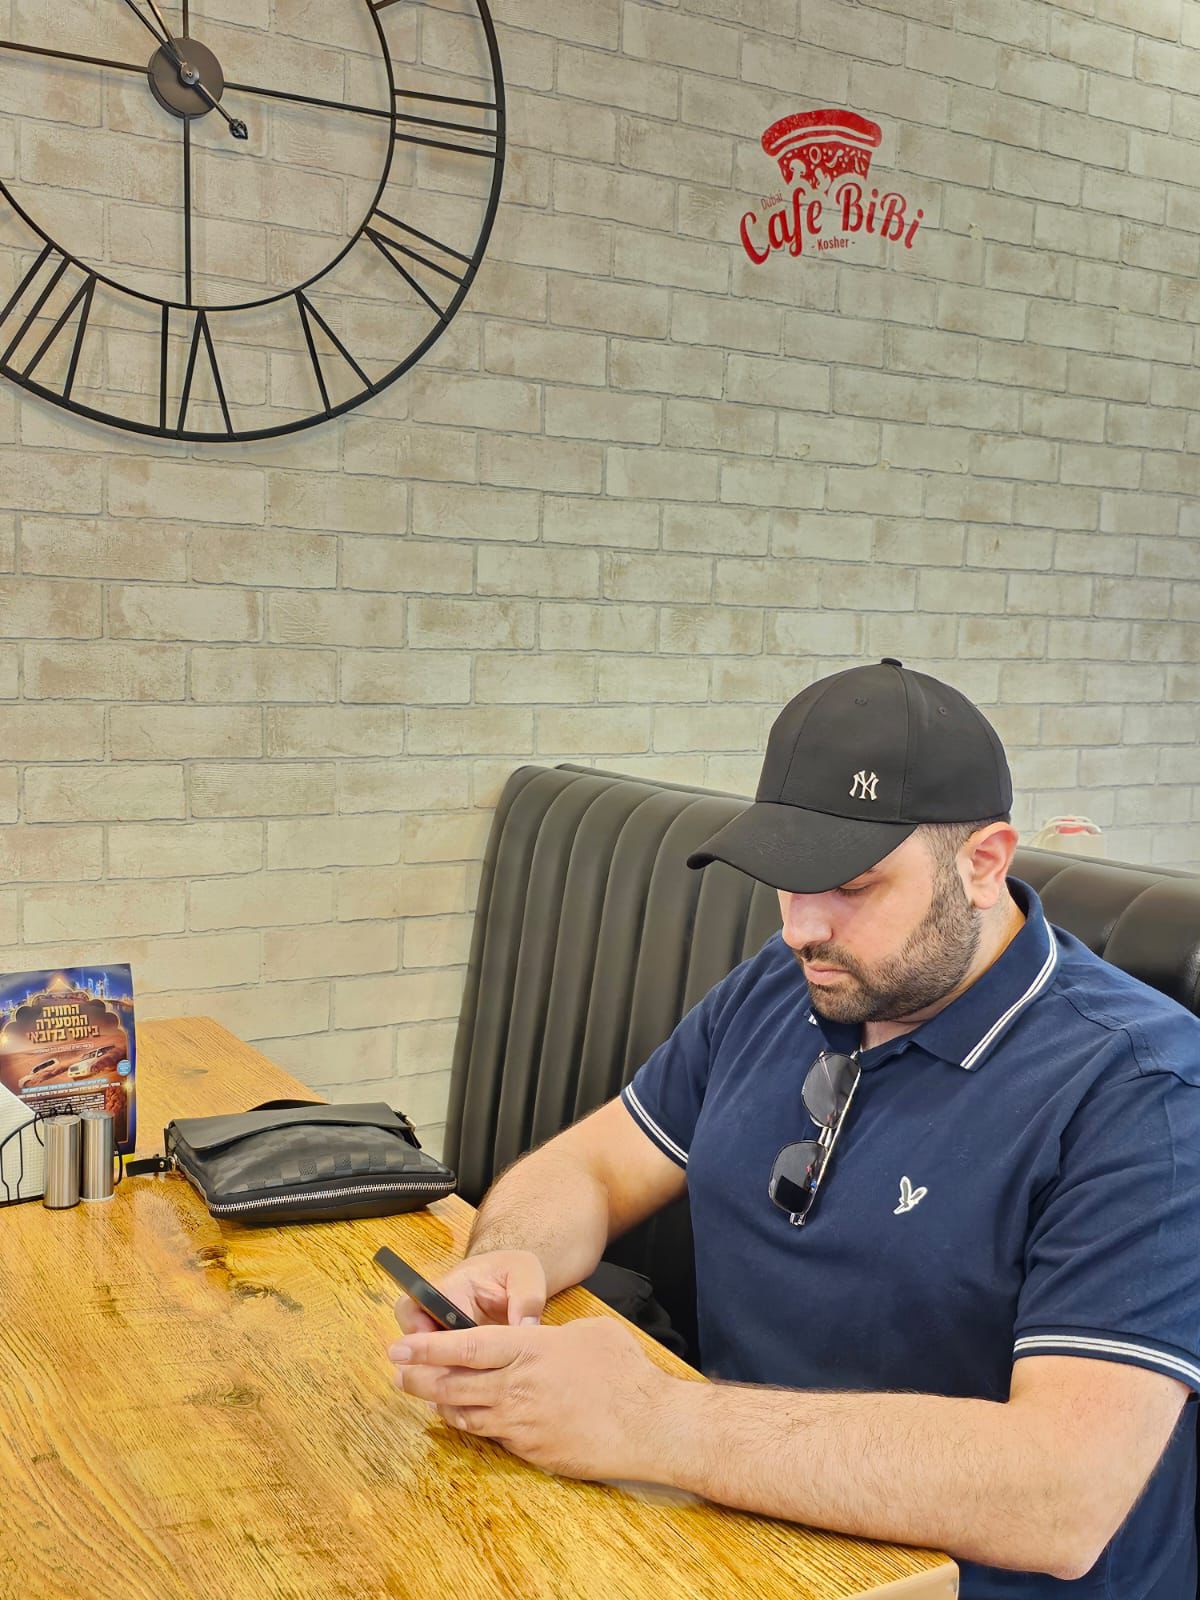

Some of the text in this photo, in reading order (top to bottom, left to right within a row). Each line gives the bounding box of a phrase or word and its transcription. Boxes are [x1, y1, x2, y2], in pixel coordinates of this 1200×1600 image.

[392, 88, 500, 158] III
[761, 190, 783, 210] Dubai
[835, 182, 924, 249] BiBi
[42, 1003, 80, 1018] החוויה
[36, 1014, 89, 1031] המסעירה
[68, 1025, 100, 1040] ביותר
